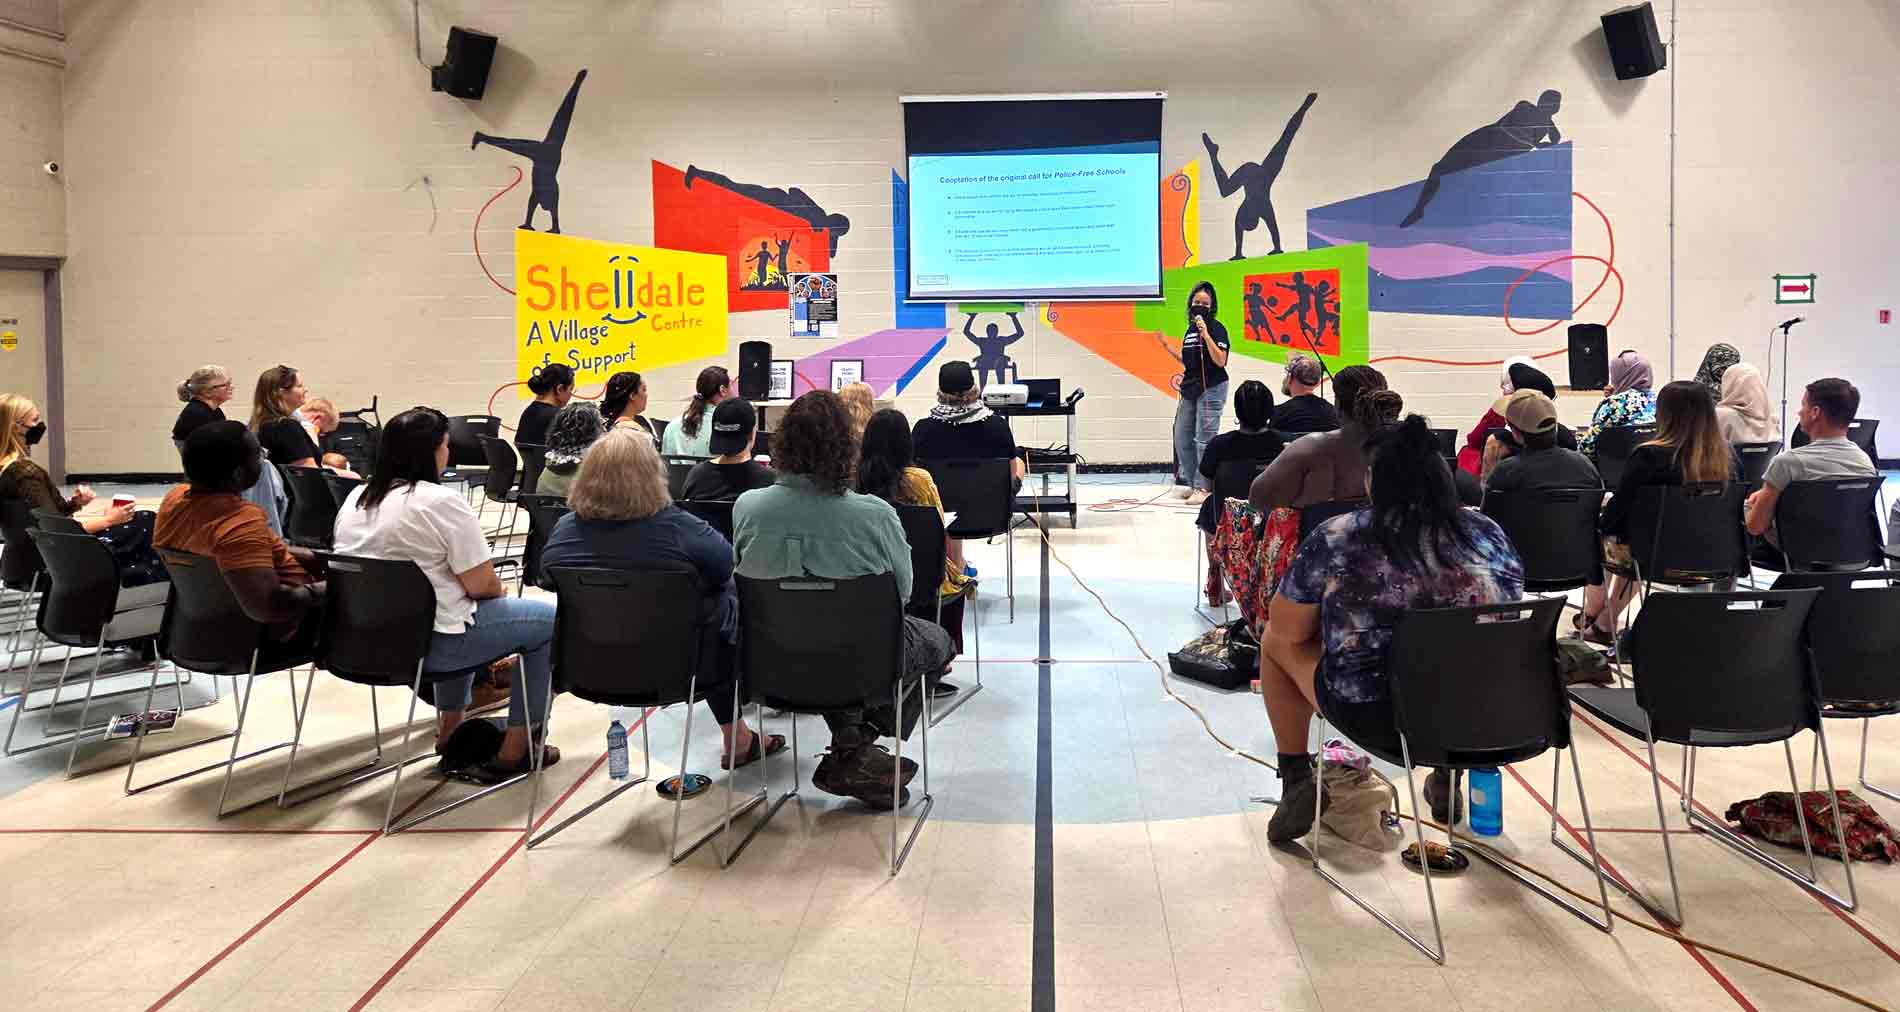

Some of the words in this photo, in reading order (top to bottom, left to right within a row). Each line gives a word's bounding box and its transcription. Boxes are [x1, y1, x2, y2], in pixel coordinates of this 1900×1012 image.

[1000, 173, 1027, 183] original
[1027, 171, 1040, 180] call
[1042, 172, 1052, 180] for
[1054, 169, 1094, 178] Police-Free
[1096, 167, 1126, 176] Schools
[526, 264, 705, 311] Shelldale
[526, 321, 543, 346] A
[548, 319, 609, 345] Village
[567, 341, 636, 374] Support
